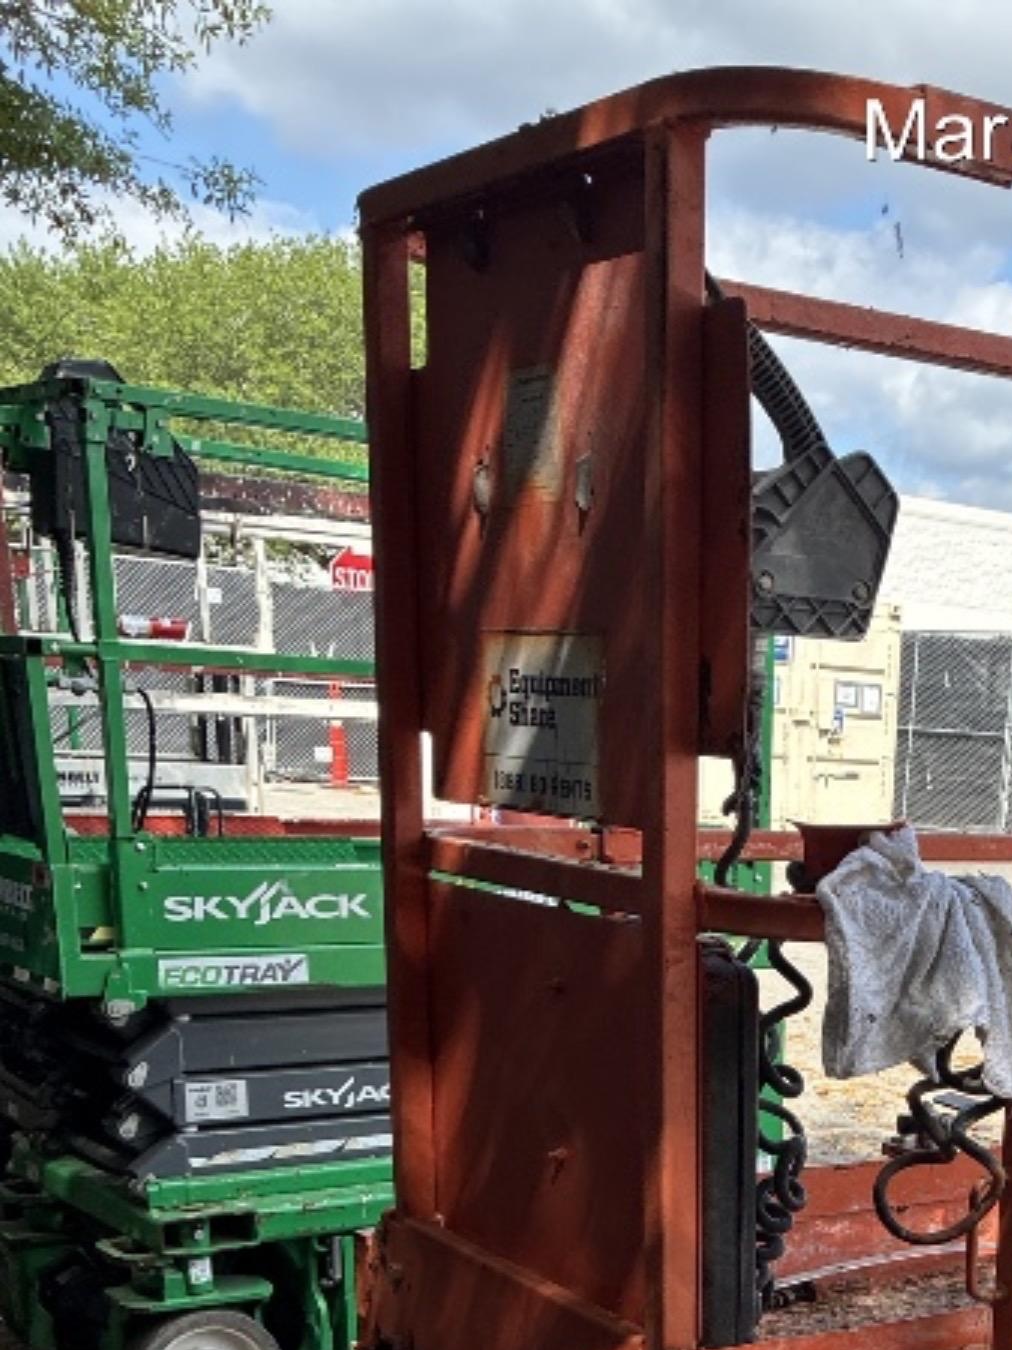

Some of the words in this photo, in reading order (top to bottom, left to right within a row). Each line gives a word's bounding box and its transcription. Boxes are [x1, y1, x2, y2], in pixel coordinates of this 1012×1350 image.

[333, 566, 374, 591] STO
[509, 668, 602, 701] Equipment
[164, 879, 372, 926] SKYJACK
[163, 958, 305, 987] ECOTRAY
